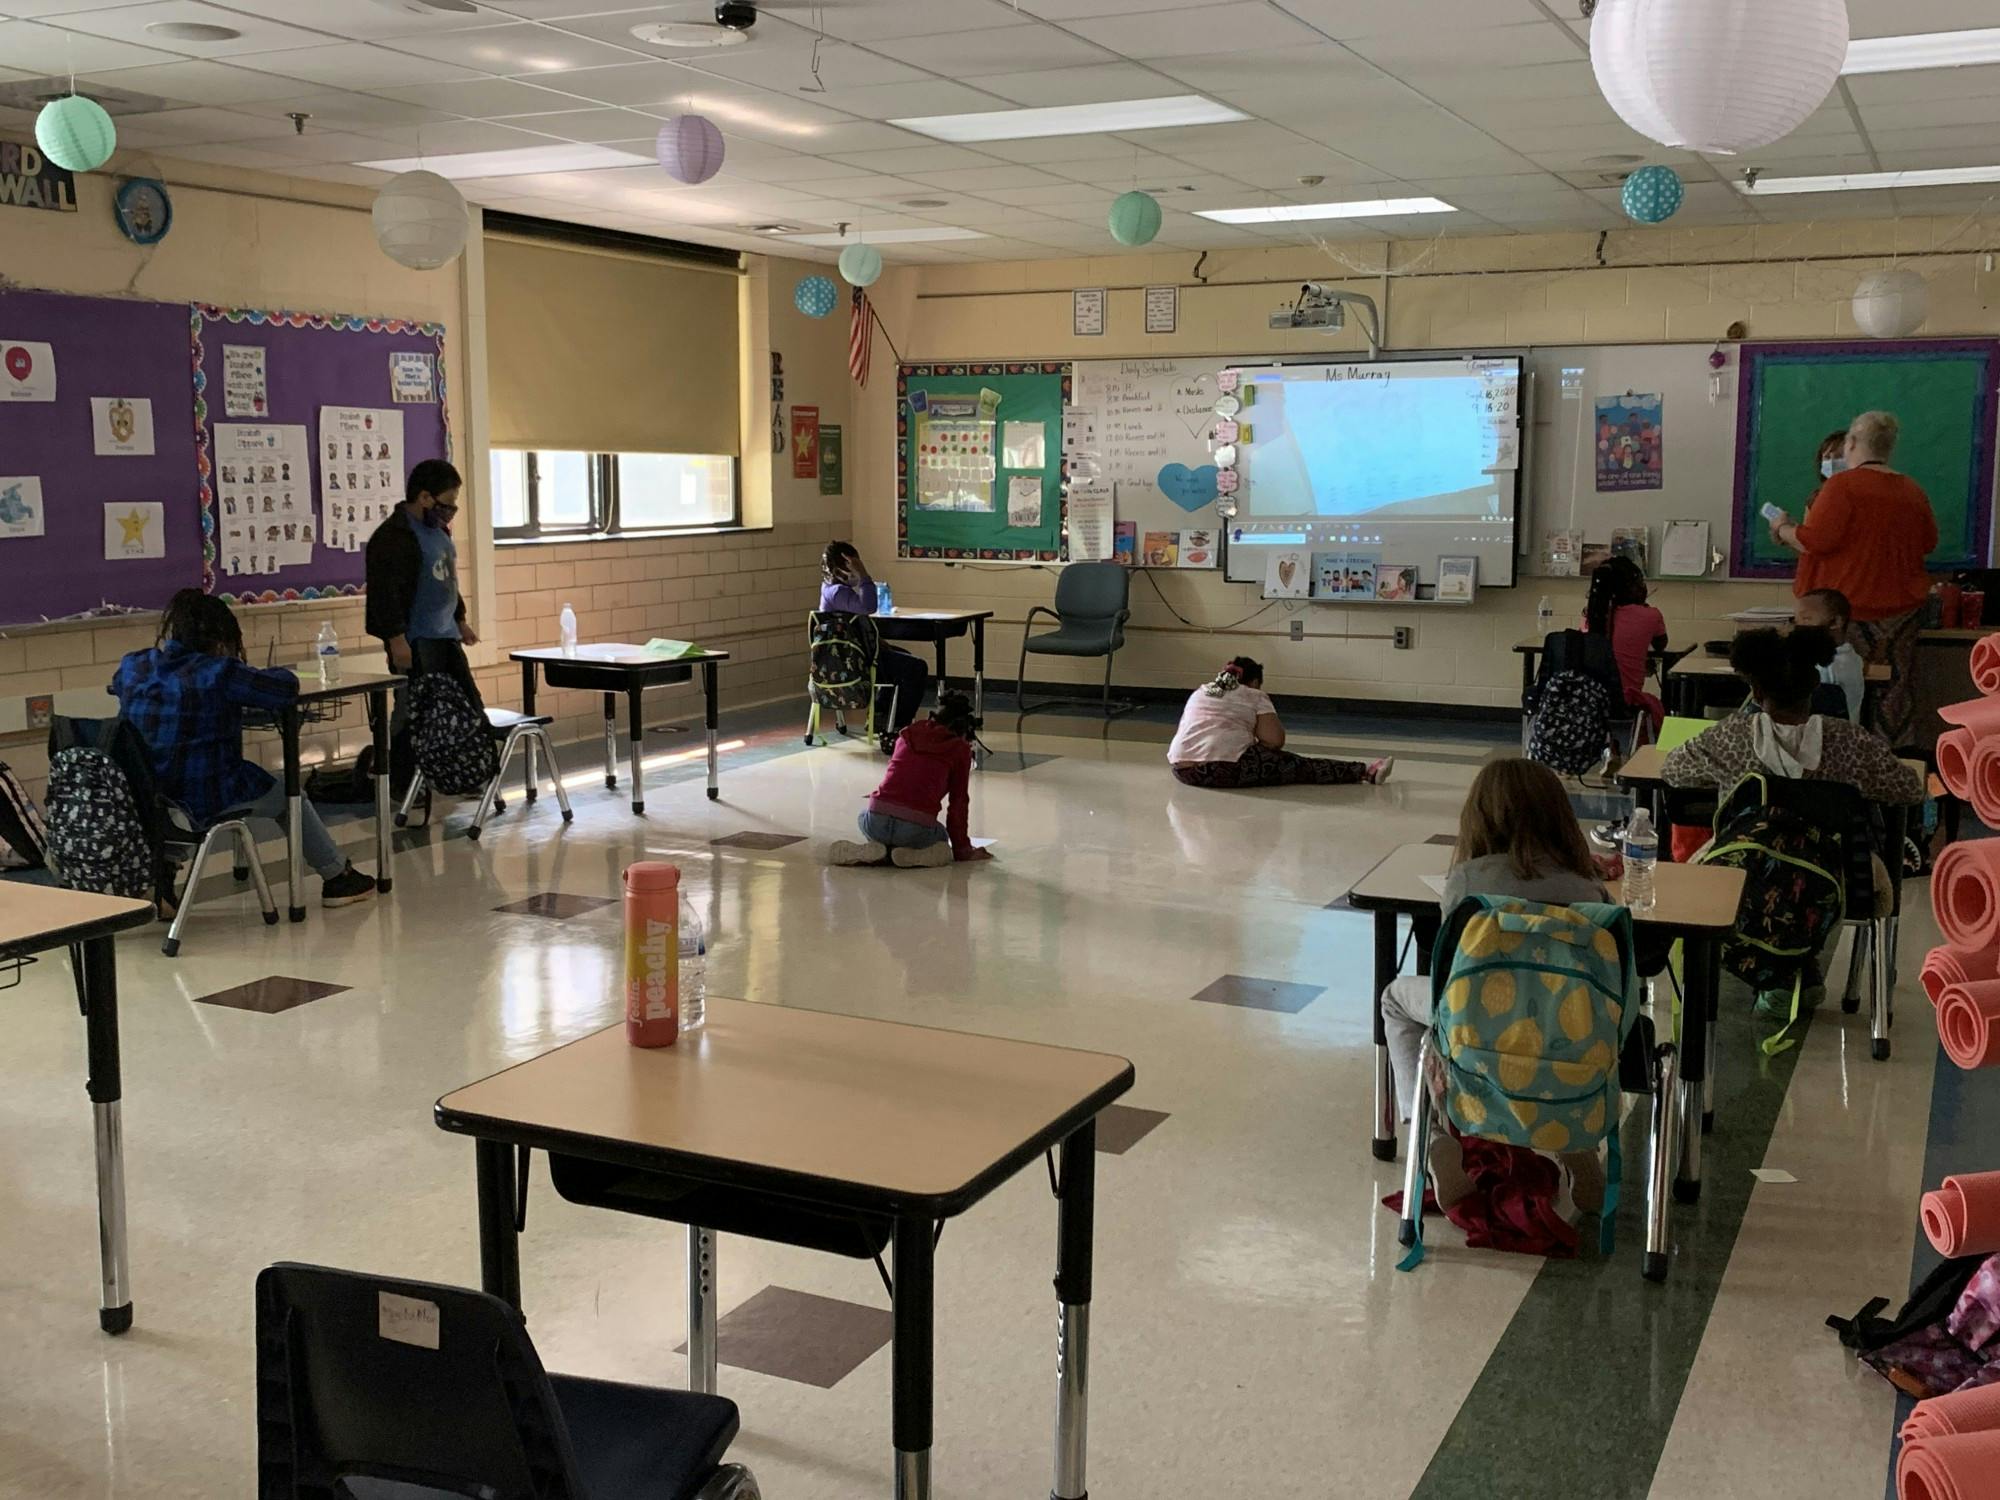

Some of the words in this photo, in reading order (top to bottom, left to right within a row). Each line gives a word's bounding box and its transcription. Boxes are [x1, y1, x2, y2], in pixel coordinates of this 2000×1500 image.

[0, 173, 76, 211] WALL
[771, 351, 785, 454] READ
[1326, 367, 1343, 382] Ms
[1347, 366, 1391, 388] Murray
[639, 918, 672, 1020] peachy
